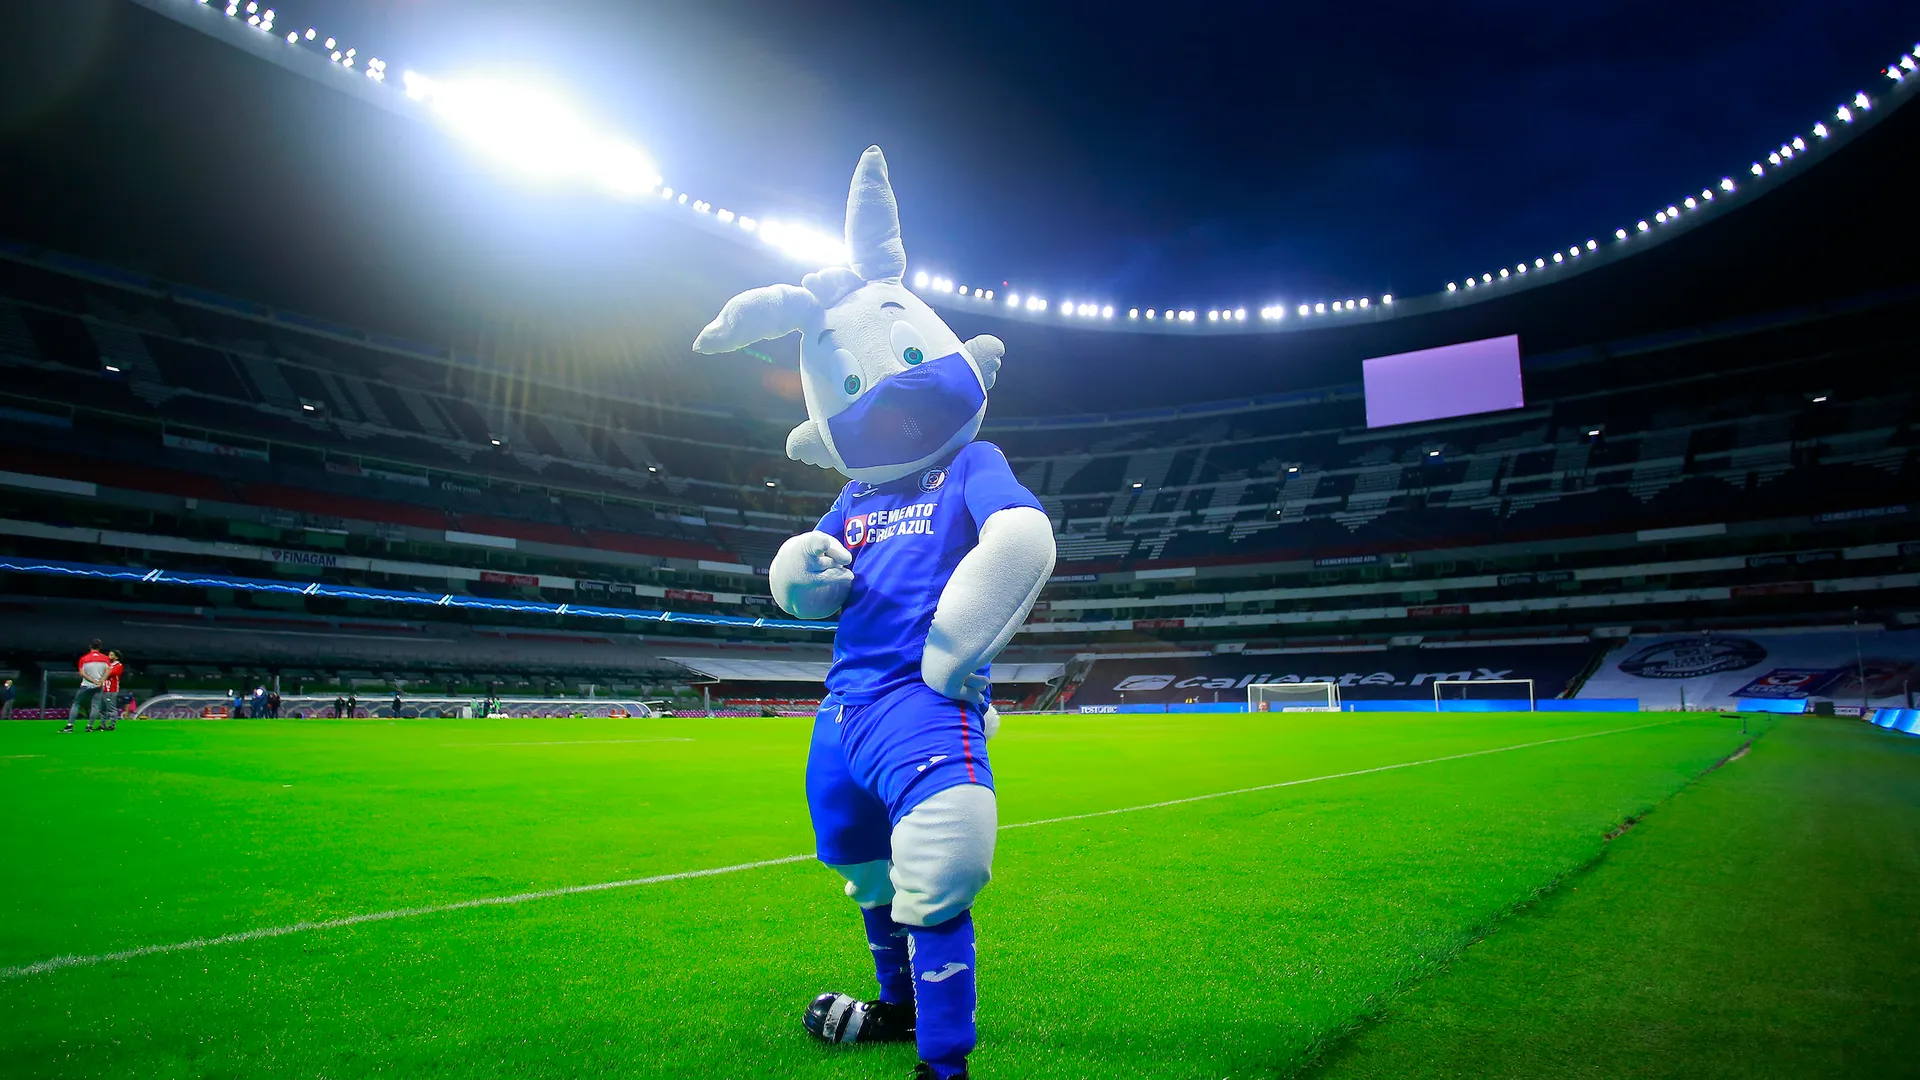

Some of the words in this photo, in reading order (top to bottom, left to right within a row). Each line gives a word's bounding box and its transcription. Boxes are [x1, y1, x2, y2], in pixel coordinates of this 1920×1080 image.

[867, 503, 933, 526] CEMENTO
[866, 526, 897, 543] CRUZ
[896, 519, 934, 536] AZUL
[283, 551, 337, 566] FINAGAM
[579, 579, 604, 592] Corona
[608, 581, 632, 594] Corona
[1174, 667, 1513, 689] caliente.mx
